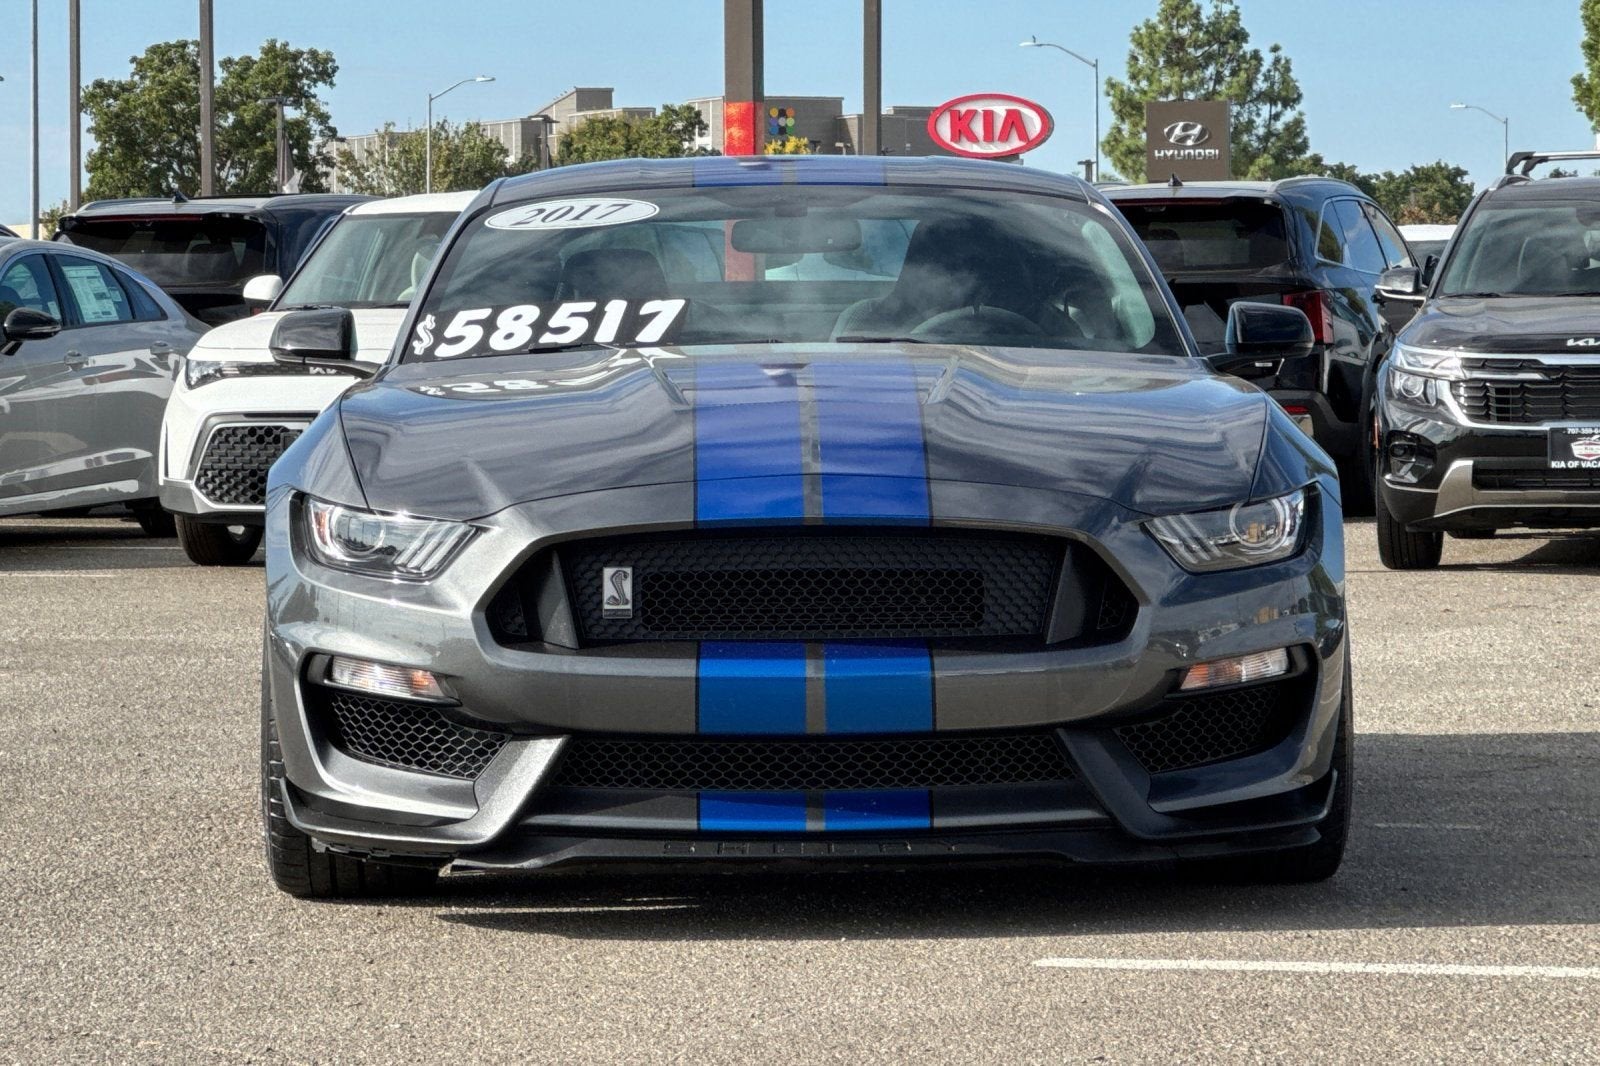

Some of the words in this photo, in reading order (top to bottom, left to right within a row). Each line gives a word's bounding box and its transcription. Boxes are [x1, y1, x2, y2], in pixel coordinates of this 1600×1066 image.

[949, 109, 1030, 143] KIA
[1154, 149, 1219, 160] HYUNDAI
[509, 203, 632, 227] 2017
[412, 299, 686, 357] $58517
